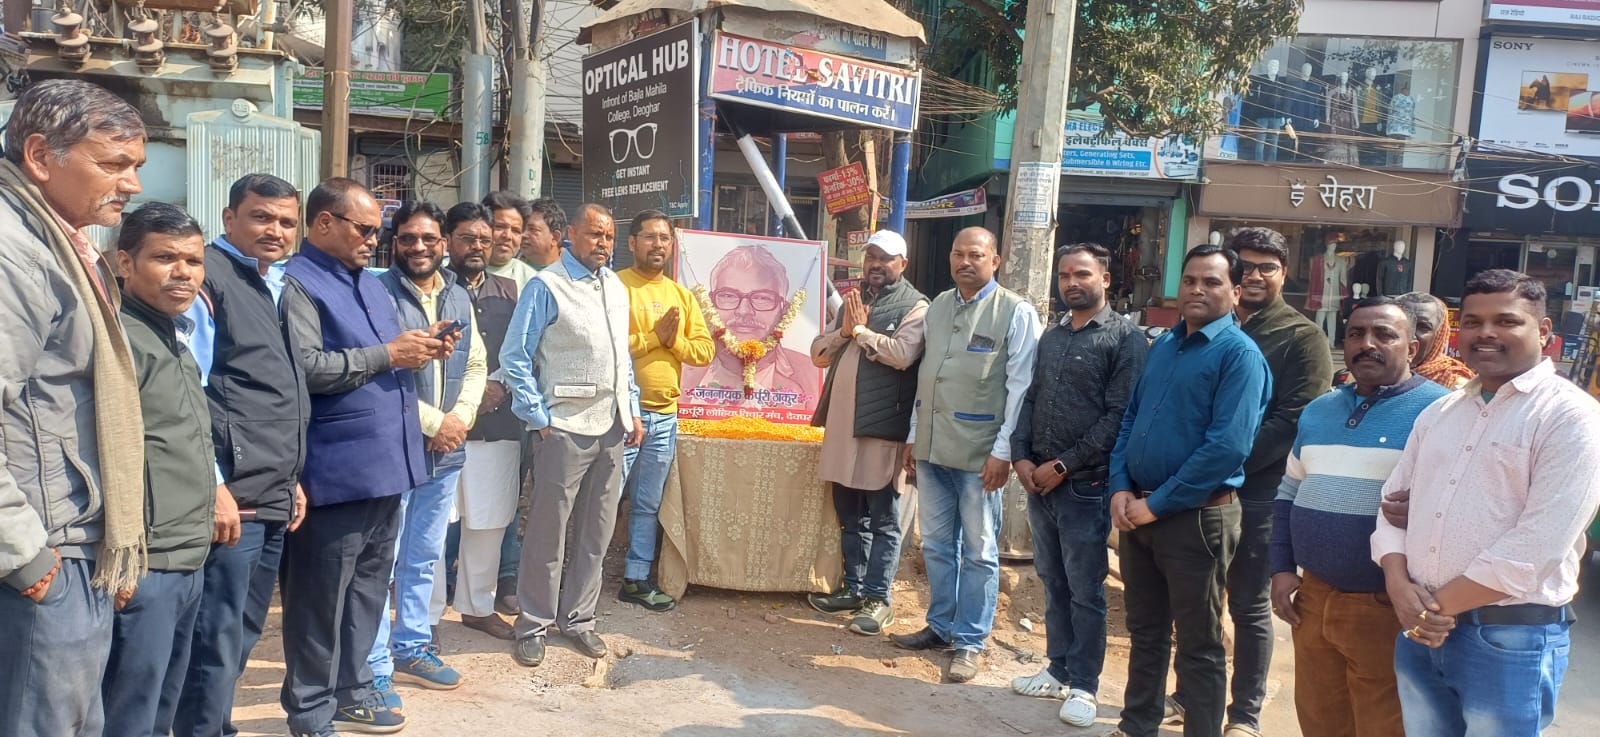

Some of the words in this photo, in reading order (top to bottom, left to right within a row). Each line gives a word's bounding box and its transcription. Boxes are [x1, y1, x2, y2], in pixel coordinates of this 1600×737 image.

[1493, 41, 1534, 50] SONY
[585, 53, 647, 95] OPTICAL
[652, 39, 689, 76] HUB
[718, 36, 807, 84] HOTEL
[816, 57, 915, 105] SAVITRI
[602, 95, 620, 109] Infront
[621, 91, 628, 104] of
[629, 88, 644, 103] Bajla
[645, 81, 667, 98] Mahila
[735, 77, 774, 96] ट्रैफिक
[778, 86, 815, 106] नियमों
[818, 95, 834, 110] का
[837, 99, 869, 116] पालन
[633, 102, 661, 118] Deoghar
[1063, 149, 1078, 157] tors,
[1080, 150, 1118, 159] Generating
[616, 168, 626, 179] GET
[627, 165, 650, 177] INSTANT
[601, 187, 614, 199] FREE
[615, 185, 628, 197] LENS
[629, 180, 669, 194] REPLACEMENT
[1319, 174, 1378, 212] सेहरा
[1496, 173, 1600, 211] SO
[695, 388, 742, 400] जननायक
[772, 392, 798, 407] ठाकुर
[678, 406, 705, 419] कर्पूरी
[706, 407, 738, 418] लोहिया
[765, 410, 784, 421] मंच,
